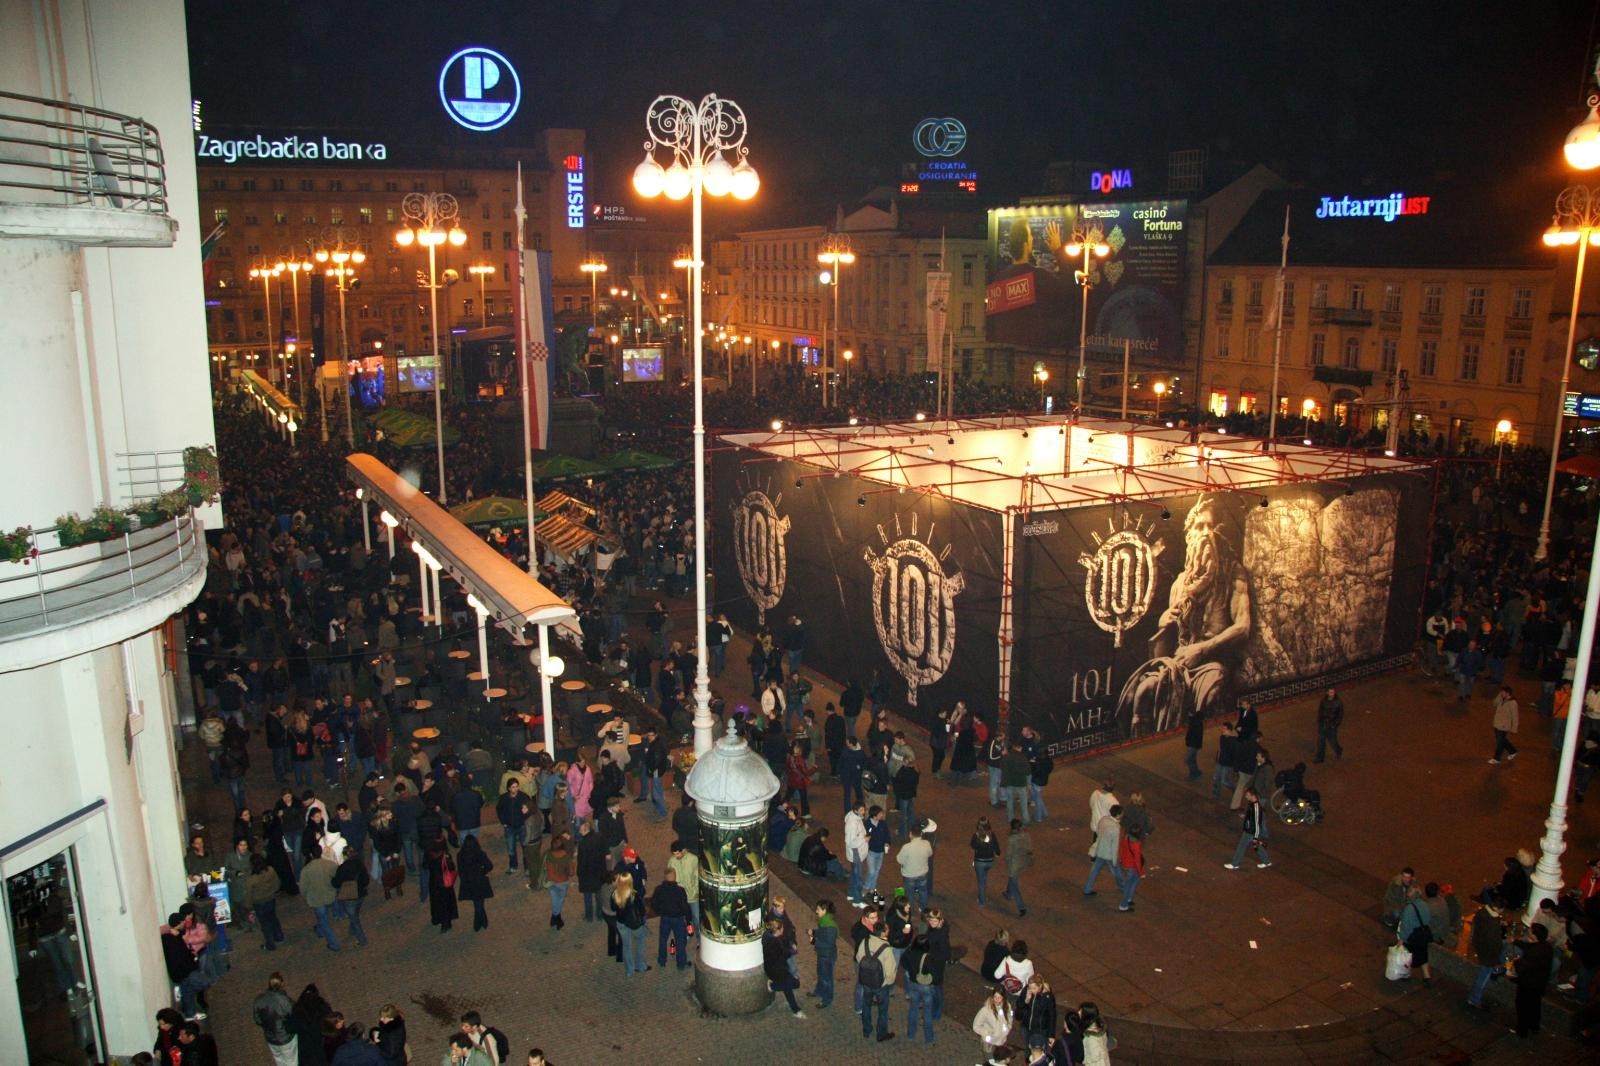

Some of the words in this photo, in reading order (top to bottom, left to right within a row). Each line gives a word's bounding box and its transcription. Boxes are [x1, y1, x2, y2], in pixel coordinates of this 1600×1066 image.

[198, 135, 319, 163] Zagrebačka
[929, 162, 967, 170] CROATIA
[918, 171, 977, 180] OSIGURANJE
[568, 172, 584, 228] ERSTE
[1316, 193, 1402, 222] Jutarnji
[1401, 197, 1430, 215] LIST
[1133, 207, 1167, 219] casino
[1144, 220, 1183, 231] Fortuna
[1008, 281, 1028, 298] MAX
[1070, 665, 1113, 703] 101
